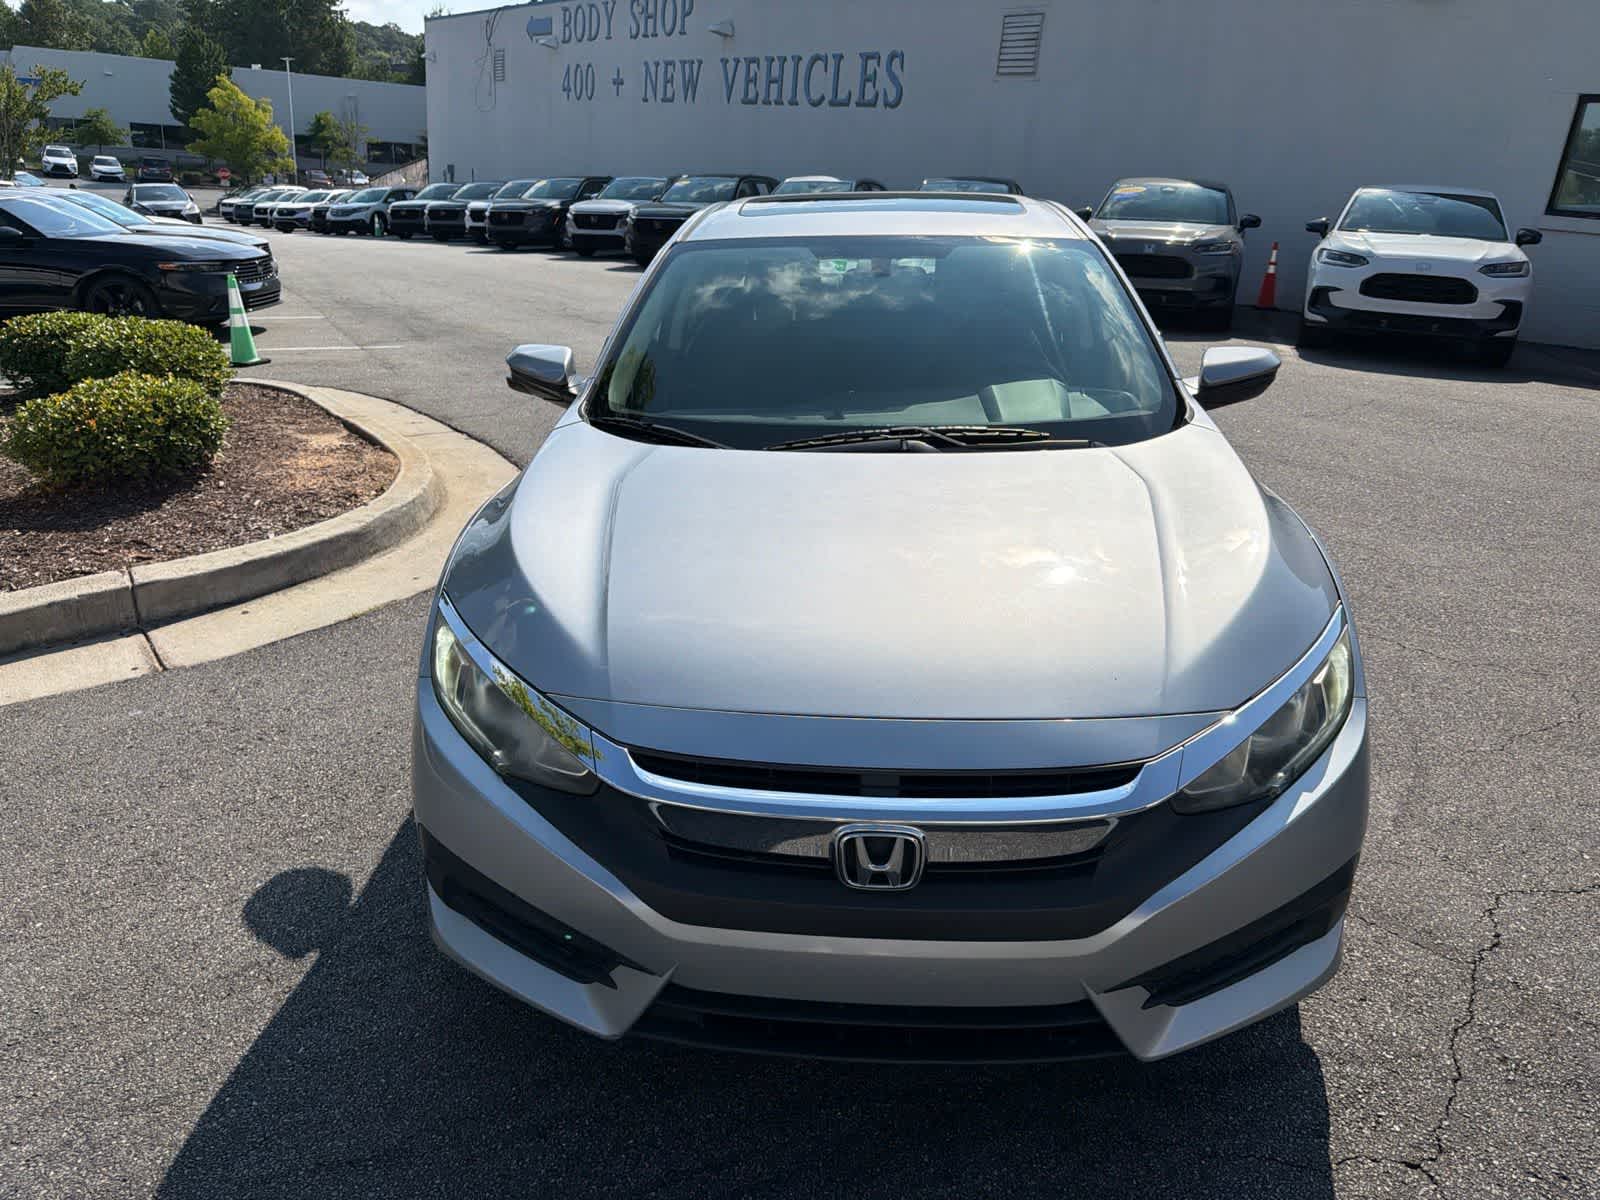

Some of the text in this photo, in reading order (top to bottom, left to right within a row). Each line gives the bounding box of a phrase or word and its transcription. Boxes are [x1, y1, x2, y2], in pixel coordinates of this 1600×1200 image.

[561, 0, 694, 44] BODY SHOP
[561, 49, 905, 109] 400 + NEW VEHICLES
